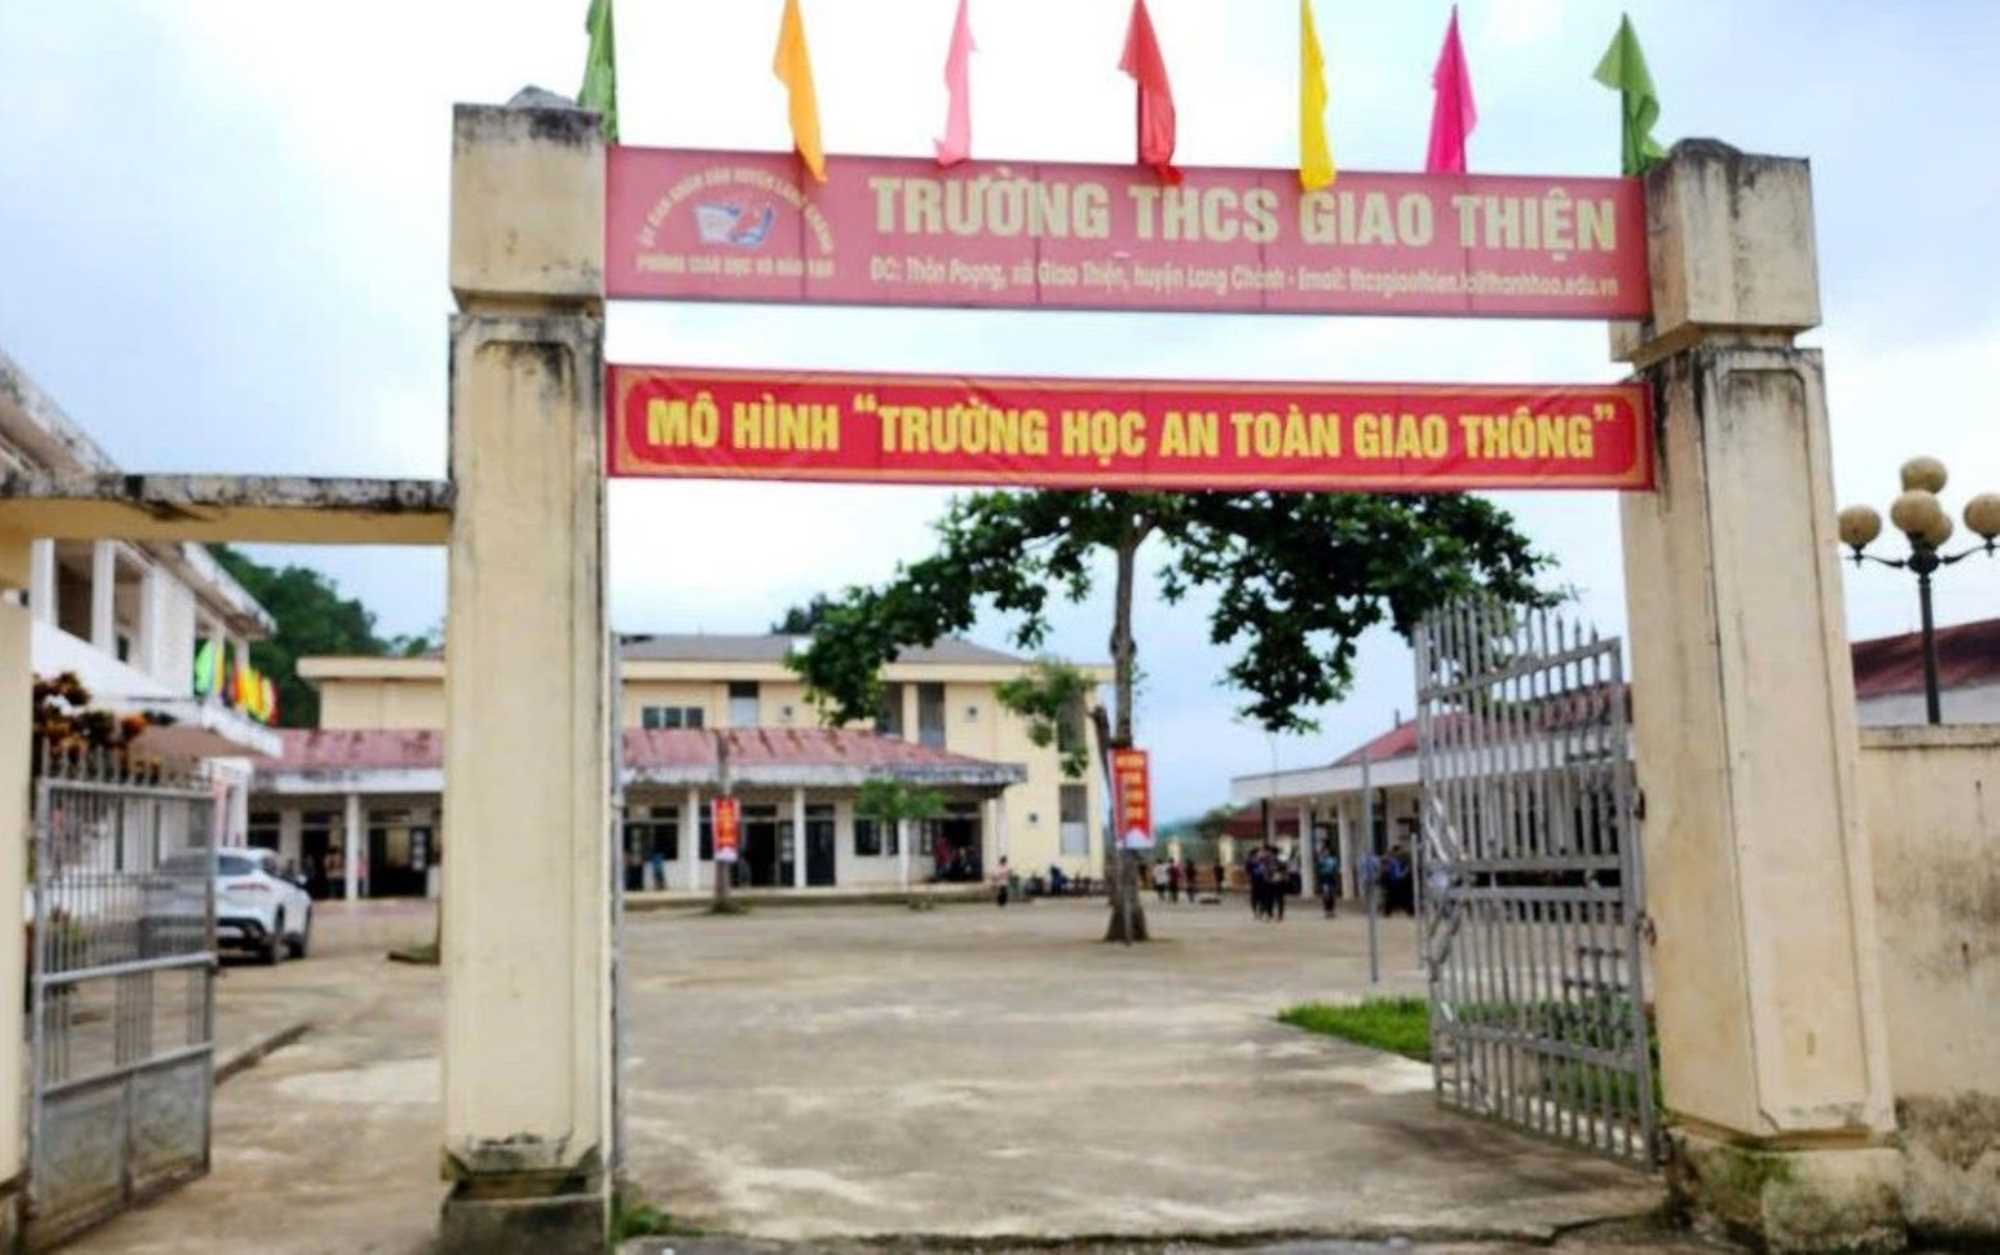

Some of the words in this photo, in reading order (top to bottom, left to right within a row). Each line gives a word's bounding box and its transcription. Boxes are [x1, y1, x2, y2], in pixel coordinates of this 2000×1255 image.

[868, 167, 1110, 240] TRƯỜNG
[1128, 184, 1281, 244] THCS
[1301, 189, 1434, 248] GIAO
[1452, 187, 1618, 261] THIỆN
[647, 391, 720, 449] MÔ
[732, 393, 840, 451] HÌNH
[1061, 409, 1148, 468] HỌC
[1160, 411, 1219, 458] AN
[1230, 404, 1341, 458] TOÀN
[1352, 413, 1449, 459] GIAO
